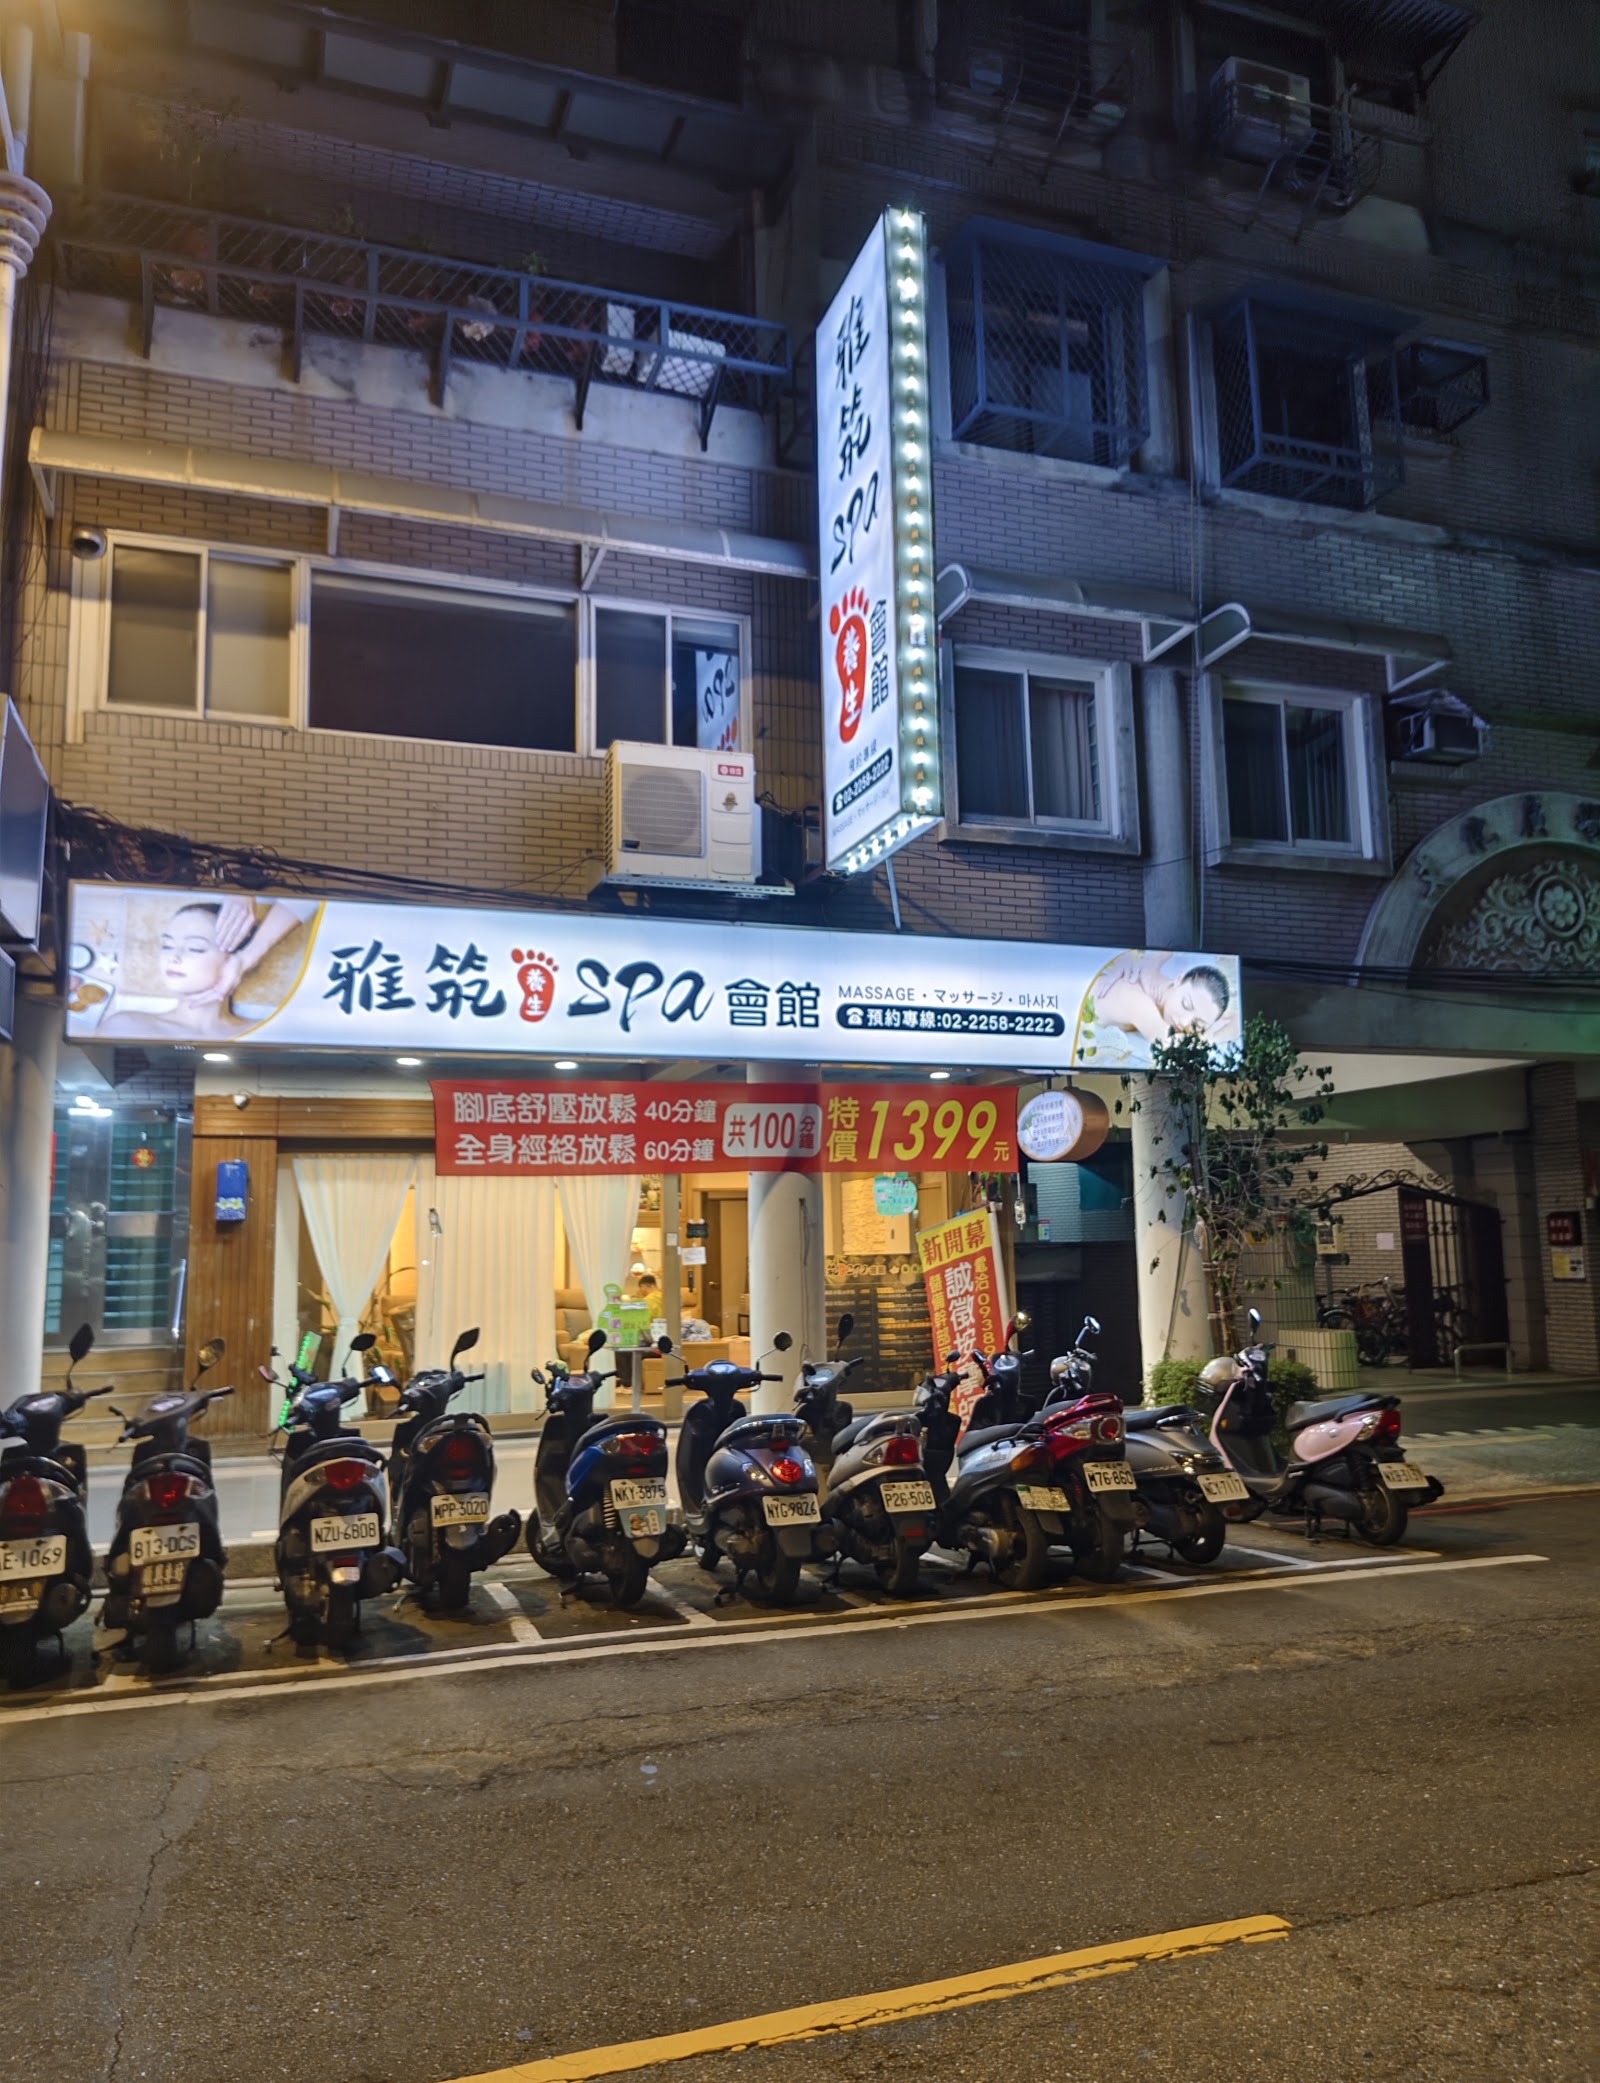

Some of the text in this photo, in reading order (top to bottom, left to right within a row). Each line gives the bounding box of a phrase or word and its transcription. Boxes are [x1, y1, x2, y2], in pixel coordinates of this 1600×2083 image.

[869, 599, 889, 714] 會館
[842, 624, 862, 728] 養生
[323, 939, 508, 1020] 雅筑
[525, 968, 547, 1017] 養生
[724, 978, 821, 1028] 會館
[838, 985, 1059, 1010] MASSAGE マッサージ 마사지
[453, 1091, 717, 1125] 腳底舒壓放鬆 40分鐘
[867, 1099, 1010, 1162] 1399 元
[454, 1132, 716, 1166] 全身經絡放鬆 60分鐘
[921, 1218, 987, 1267] 新開幕
[614, 1484, 667, 1502] NKY-3875
[766, 1501, 817, 1518] NYG-9826
[884, 1490, 933, 1508] P26-508
[314, 1522, 377, 1544] NZU-6808
[0, 1546, 63, 1570] E-1069
